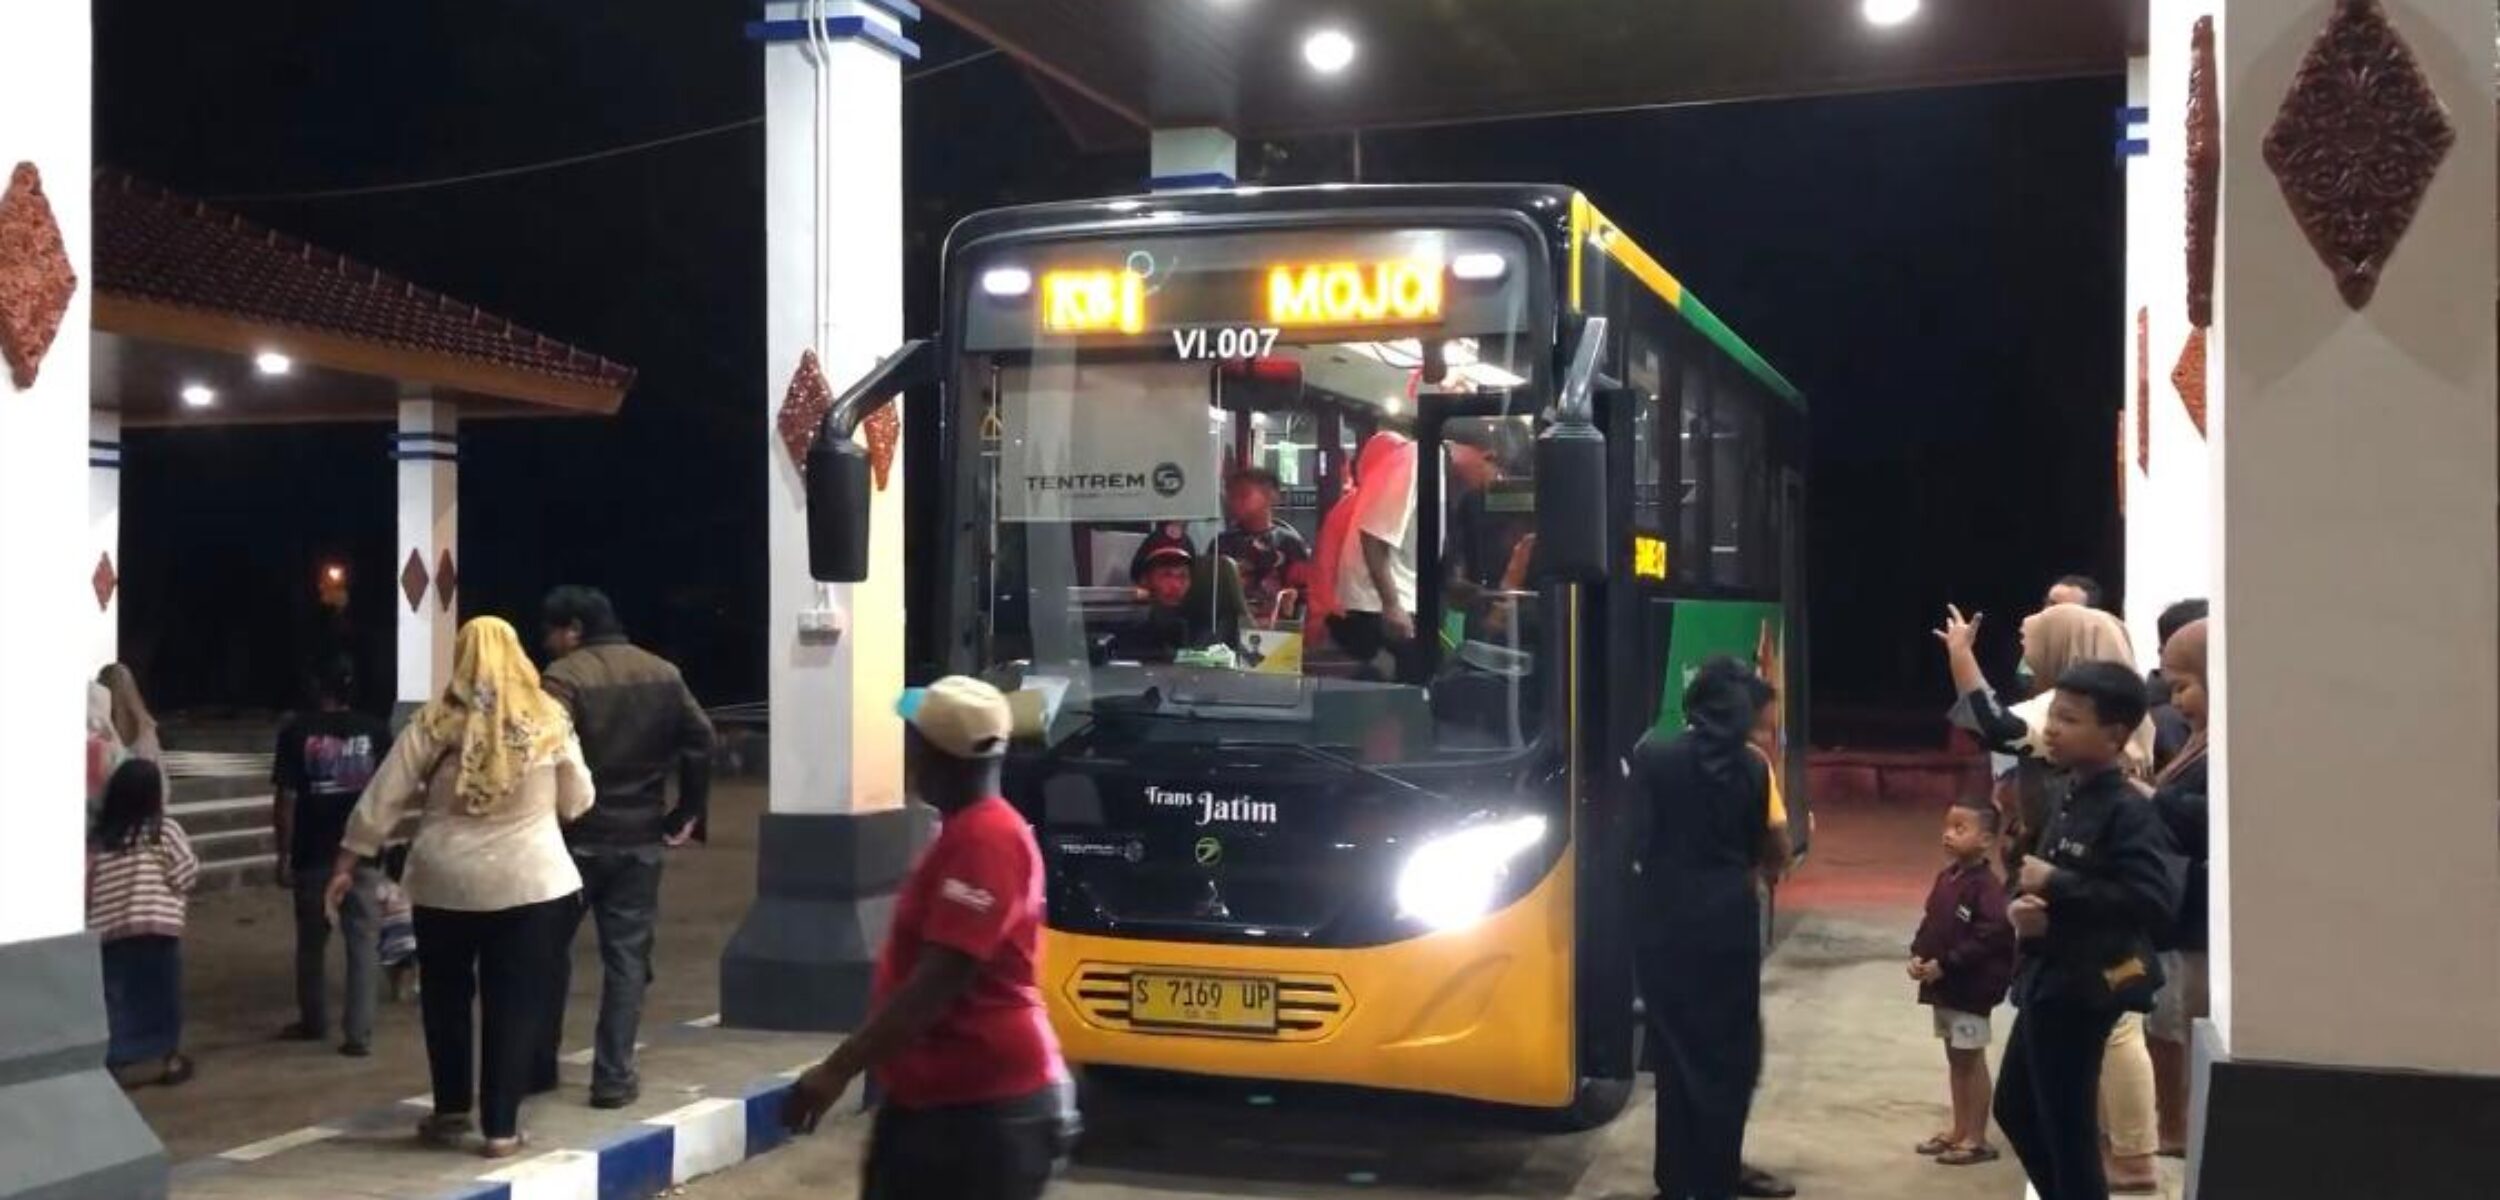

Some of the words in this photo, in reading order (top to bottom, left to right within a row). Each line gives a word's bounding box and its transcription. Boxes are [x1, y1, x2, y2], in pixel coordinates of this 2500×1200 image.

[1173, 328, 1280, 359] VI.007
[1025, 473, 1145, 491] TENTREM
[1145, 786, 1193, 806] Trans
[1196, 791, 1277, 826] Jatim
[1137, 978, 1149, 1004] S
[1167, 980, 1222, 1009] 7169
[1241, 983, 1270, 1010] UP
